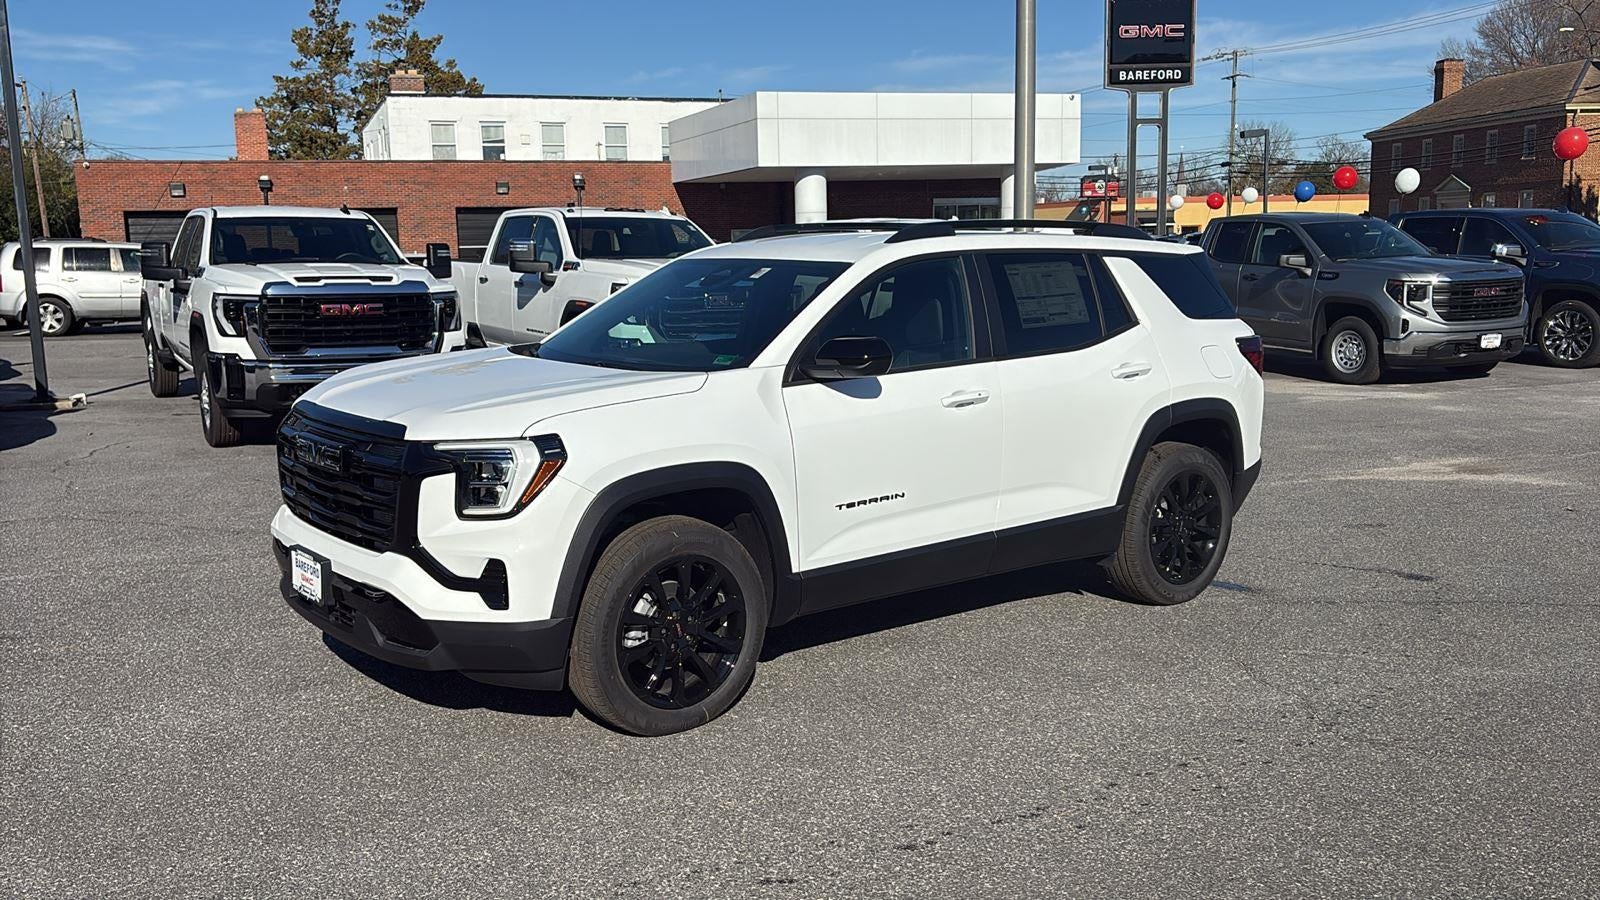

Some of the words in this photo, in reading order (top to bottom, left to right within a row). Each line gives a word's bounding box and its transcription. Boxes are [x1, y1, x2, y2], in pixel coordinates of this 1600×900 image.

[1119, 24, 1184, 38] GMC
[1119, 69, 1182, 80] BAREFORD
[320, 303, 384, 316] GMC
[295, 437, 341, 471] GMC
[835, 492, 905, 510] TERRAIN
[295, 557, 320, 579] BAREFORD
[300, 573, 316, 587] GMC
